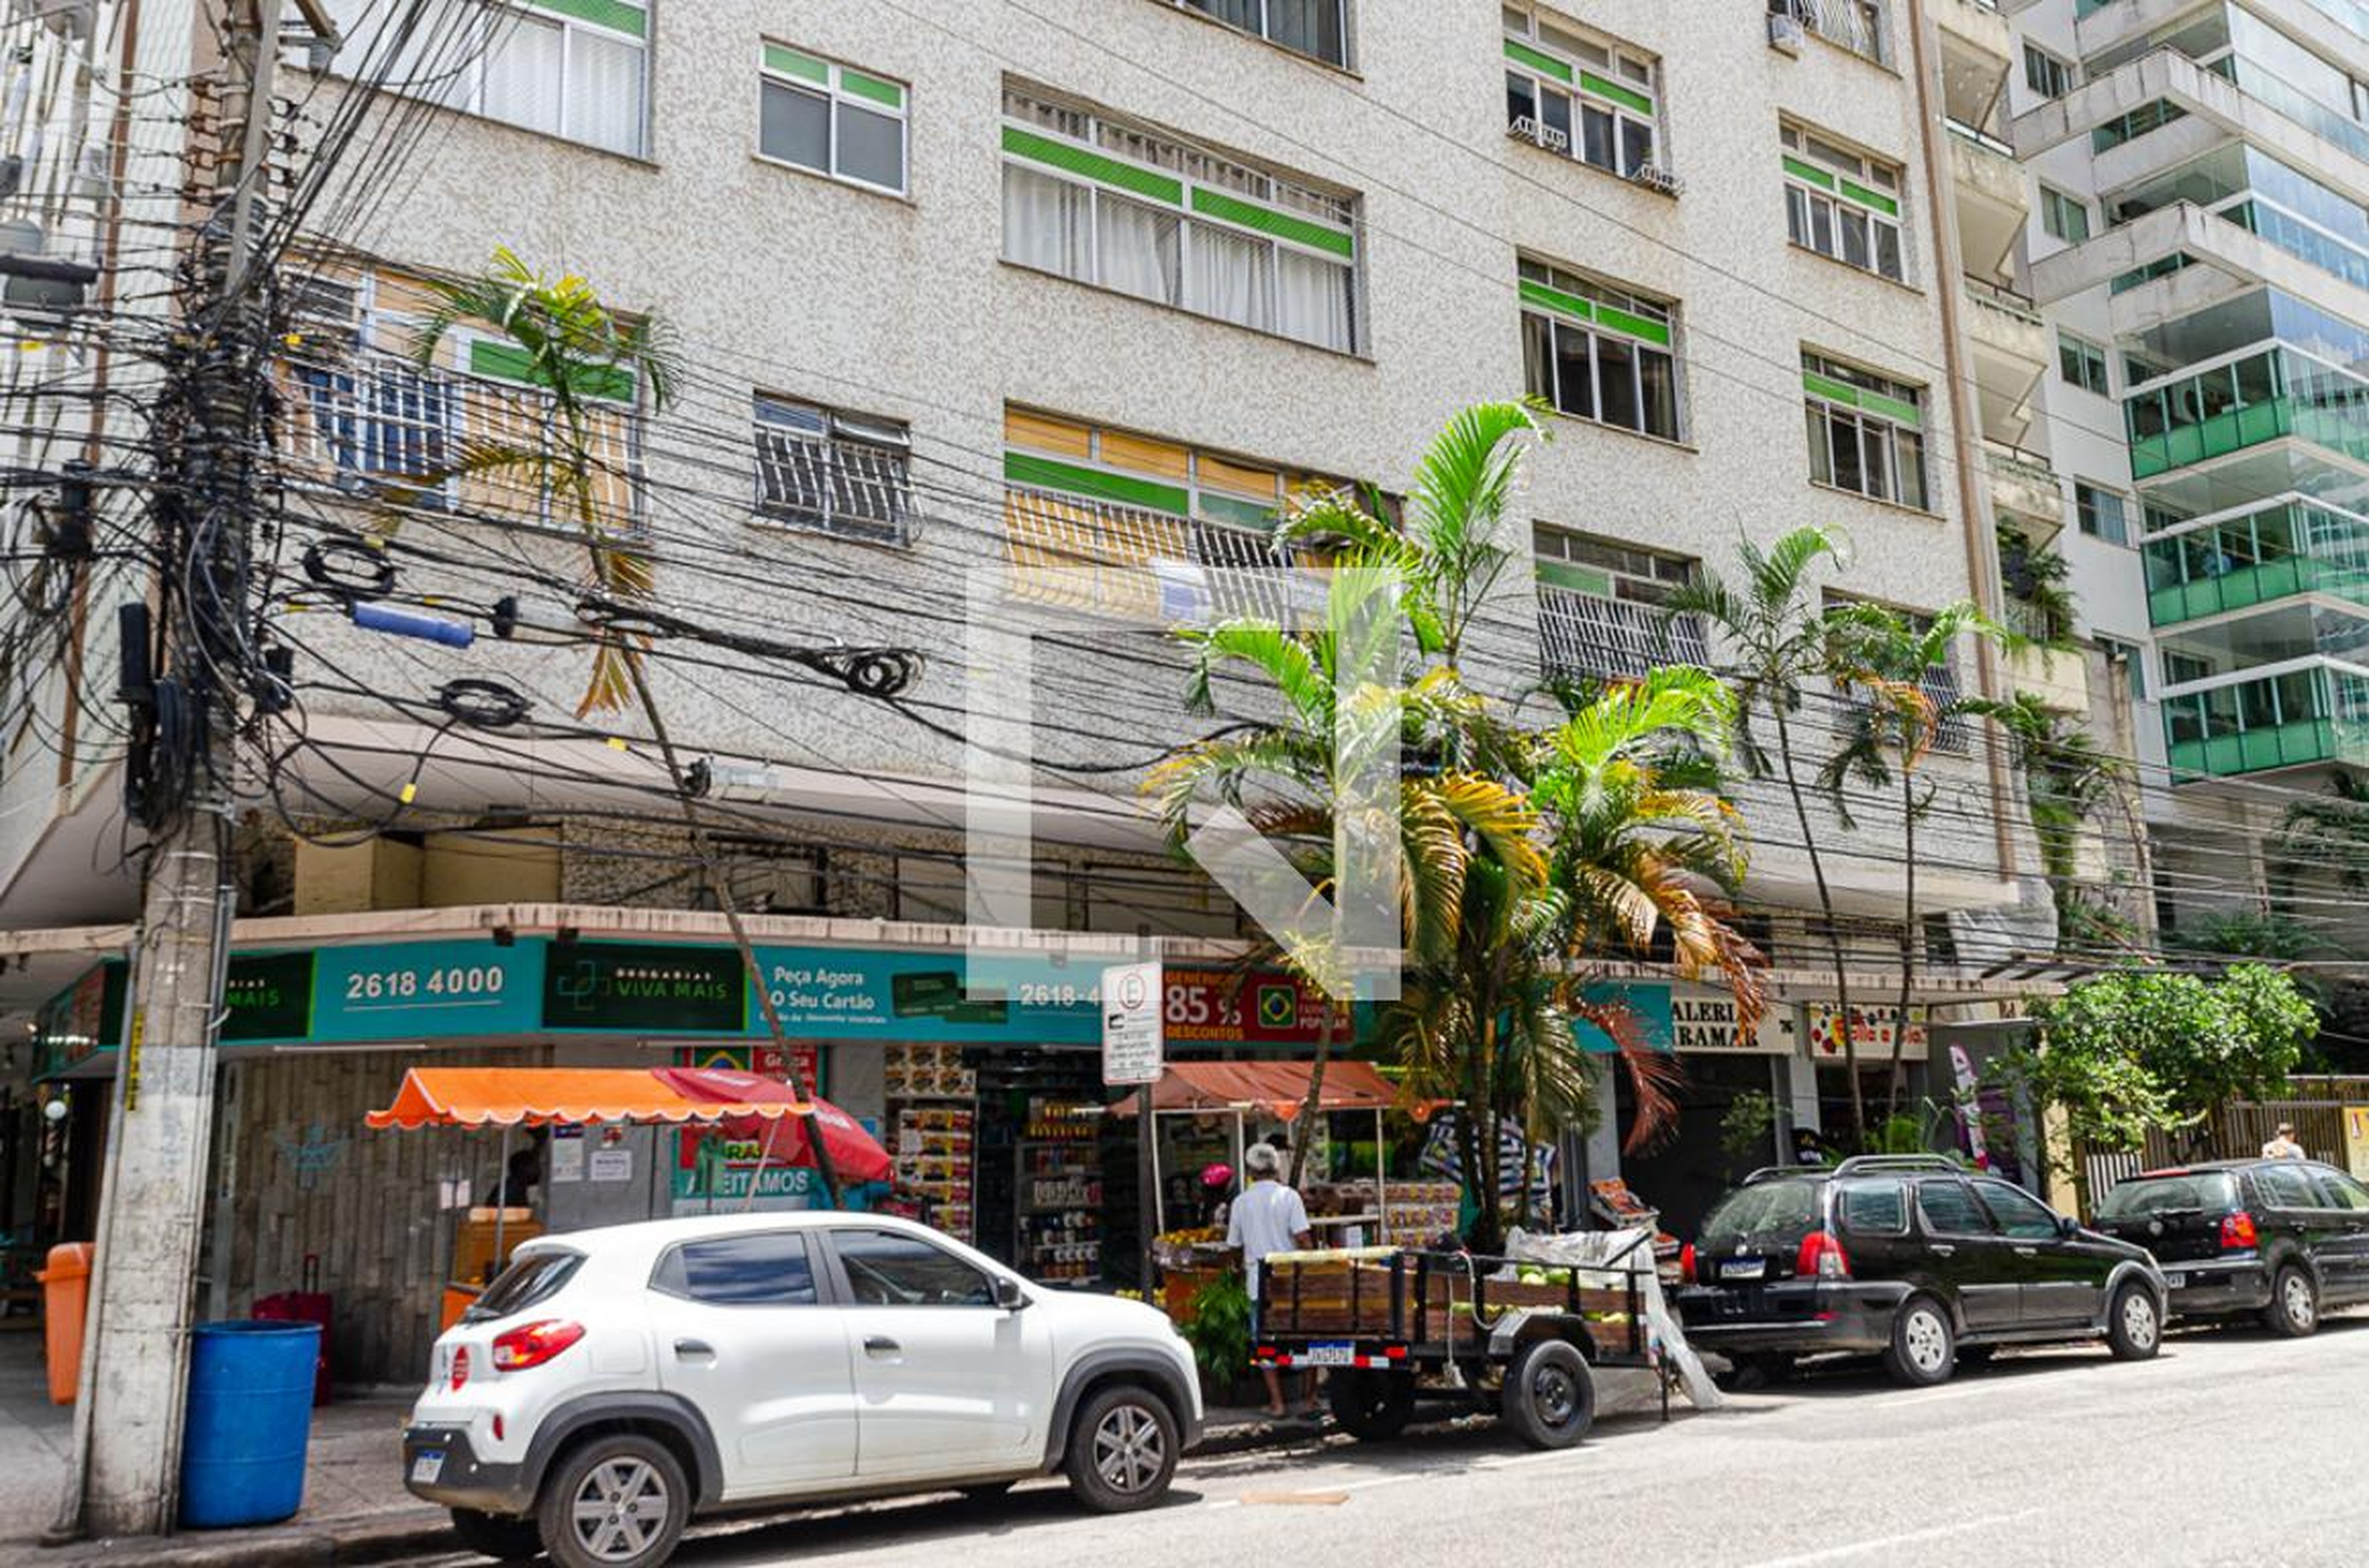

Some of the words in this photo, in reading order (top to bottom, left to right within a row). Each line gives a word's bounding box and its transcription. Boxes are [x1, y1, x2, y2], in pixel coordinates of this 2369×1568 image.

[346, 972, 417, 999] 2618
[426, 967, 503, 994] 4000
[774, 966, 811, 987] Peça
[816, 968, 864, 989] Agora
[617, 980, 667, 997] VIVA
[674, 982, 729, 999] MAIS
[771, 989, 785, 1006] O
[788, 991, 818, 1008] Seu
[1020, 983, 1099, 1007] 2618-4
[1165, 987, 1209, 1023] 85
[1672, 1001, 1734, 1022] ALERI
[1672, 1026, 1759, 1047] RAMAR
[686, 1170, 809, 1195] EITAMOS
